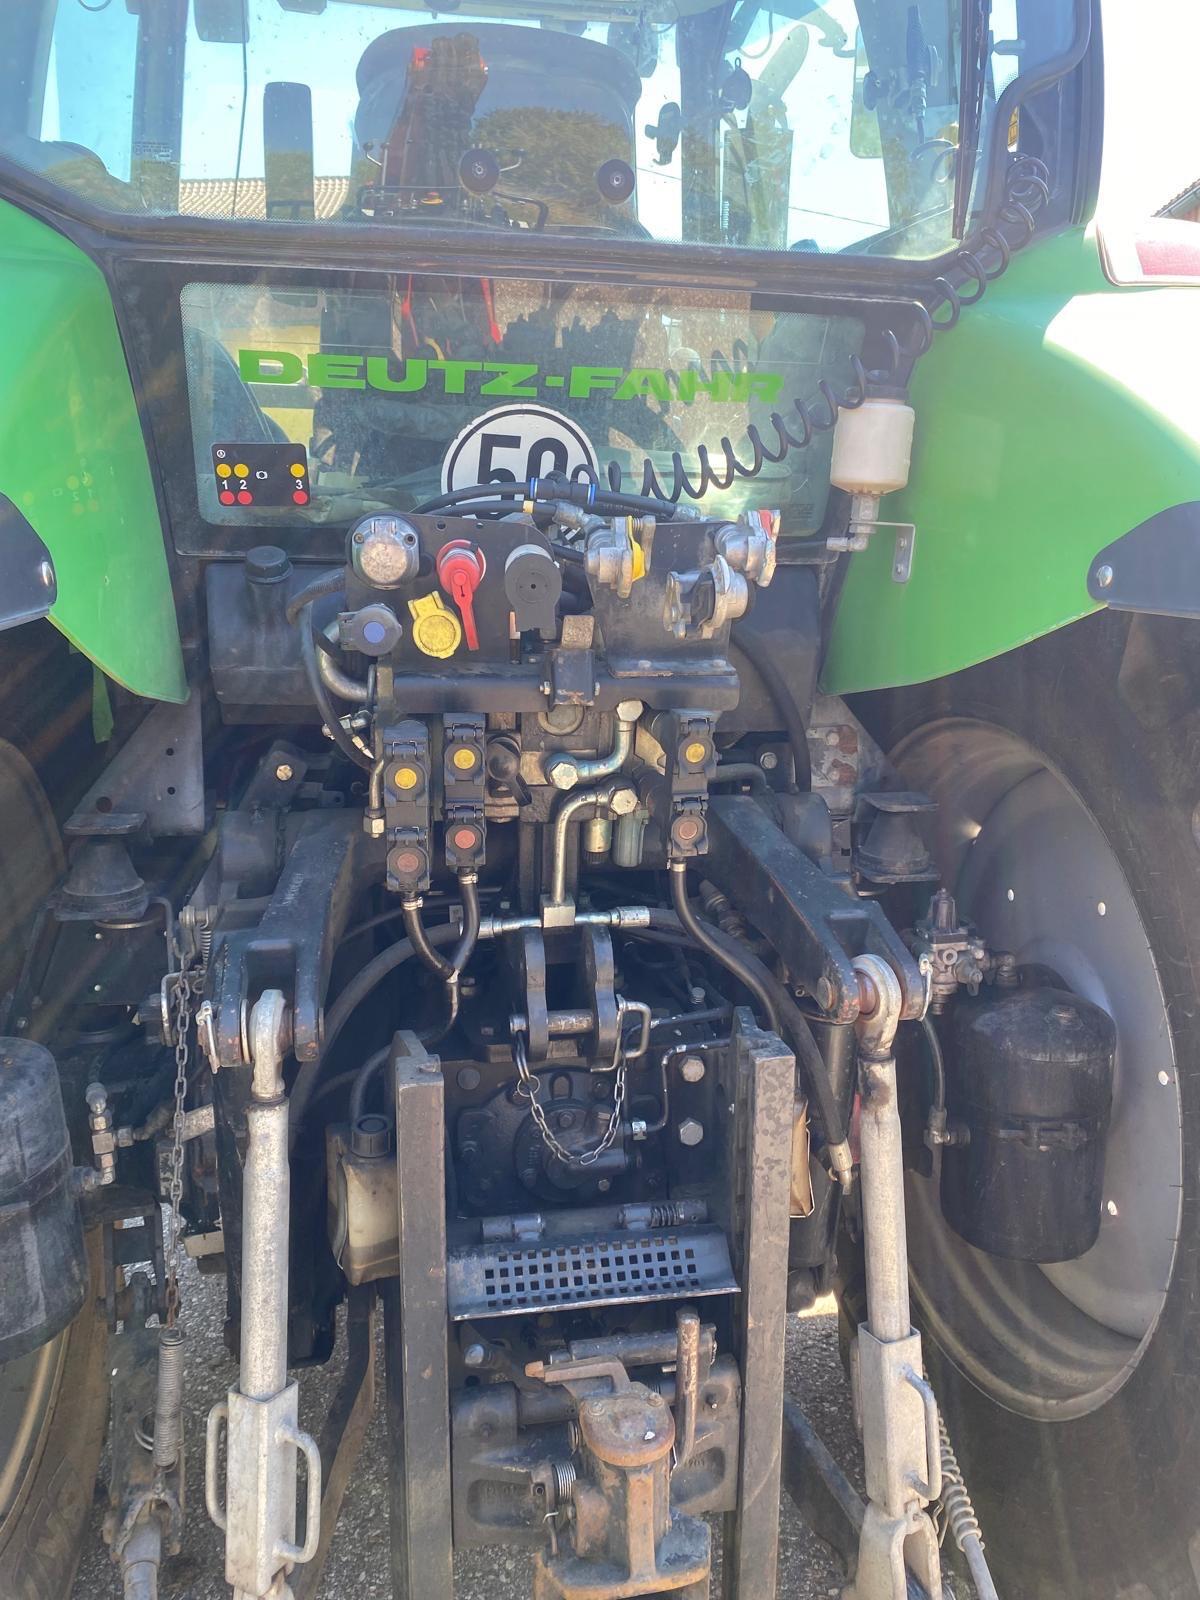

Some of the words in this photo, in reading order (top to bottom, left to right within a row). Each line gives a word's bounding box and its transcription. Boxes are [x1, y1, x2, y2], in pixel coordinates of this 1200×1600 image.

[238, 349, 785, 404] DEUTZ-FAHR
[222, 479, 229, 490] 1
[239, 479, 248, 490] 2
[295, 479, 304, 490] 3
[477, 432, 569, 505] 50
